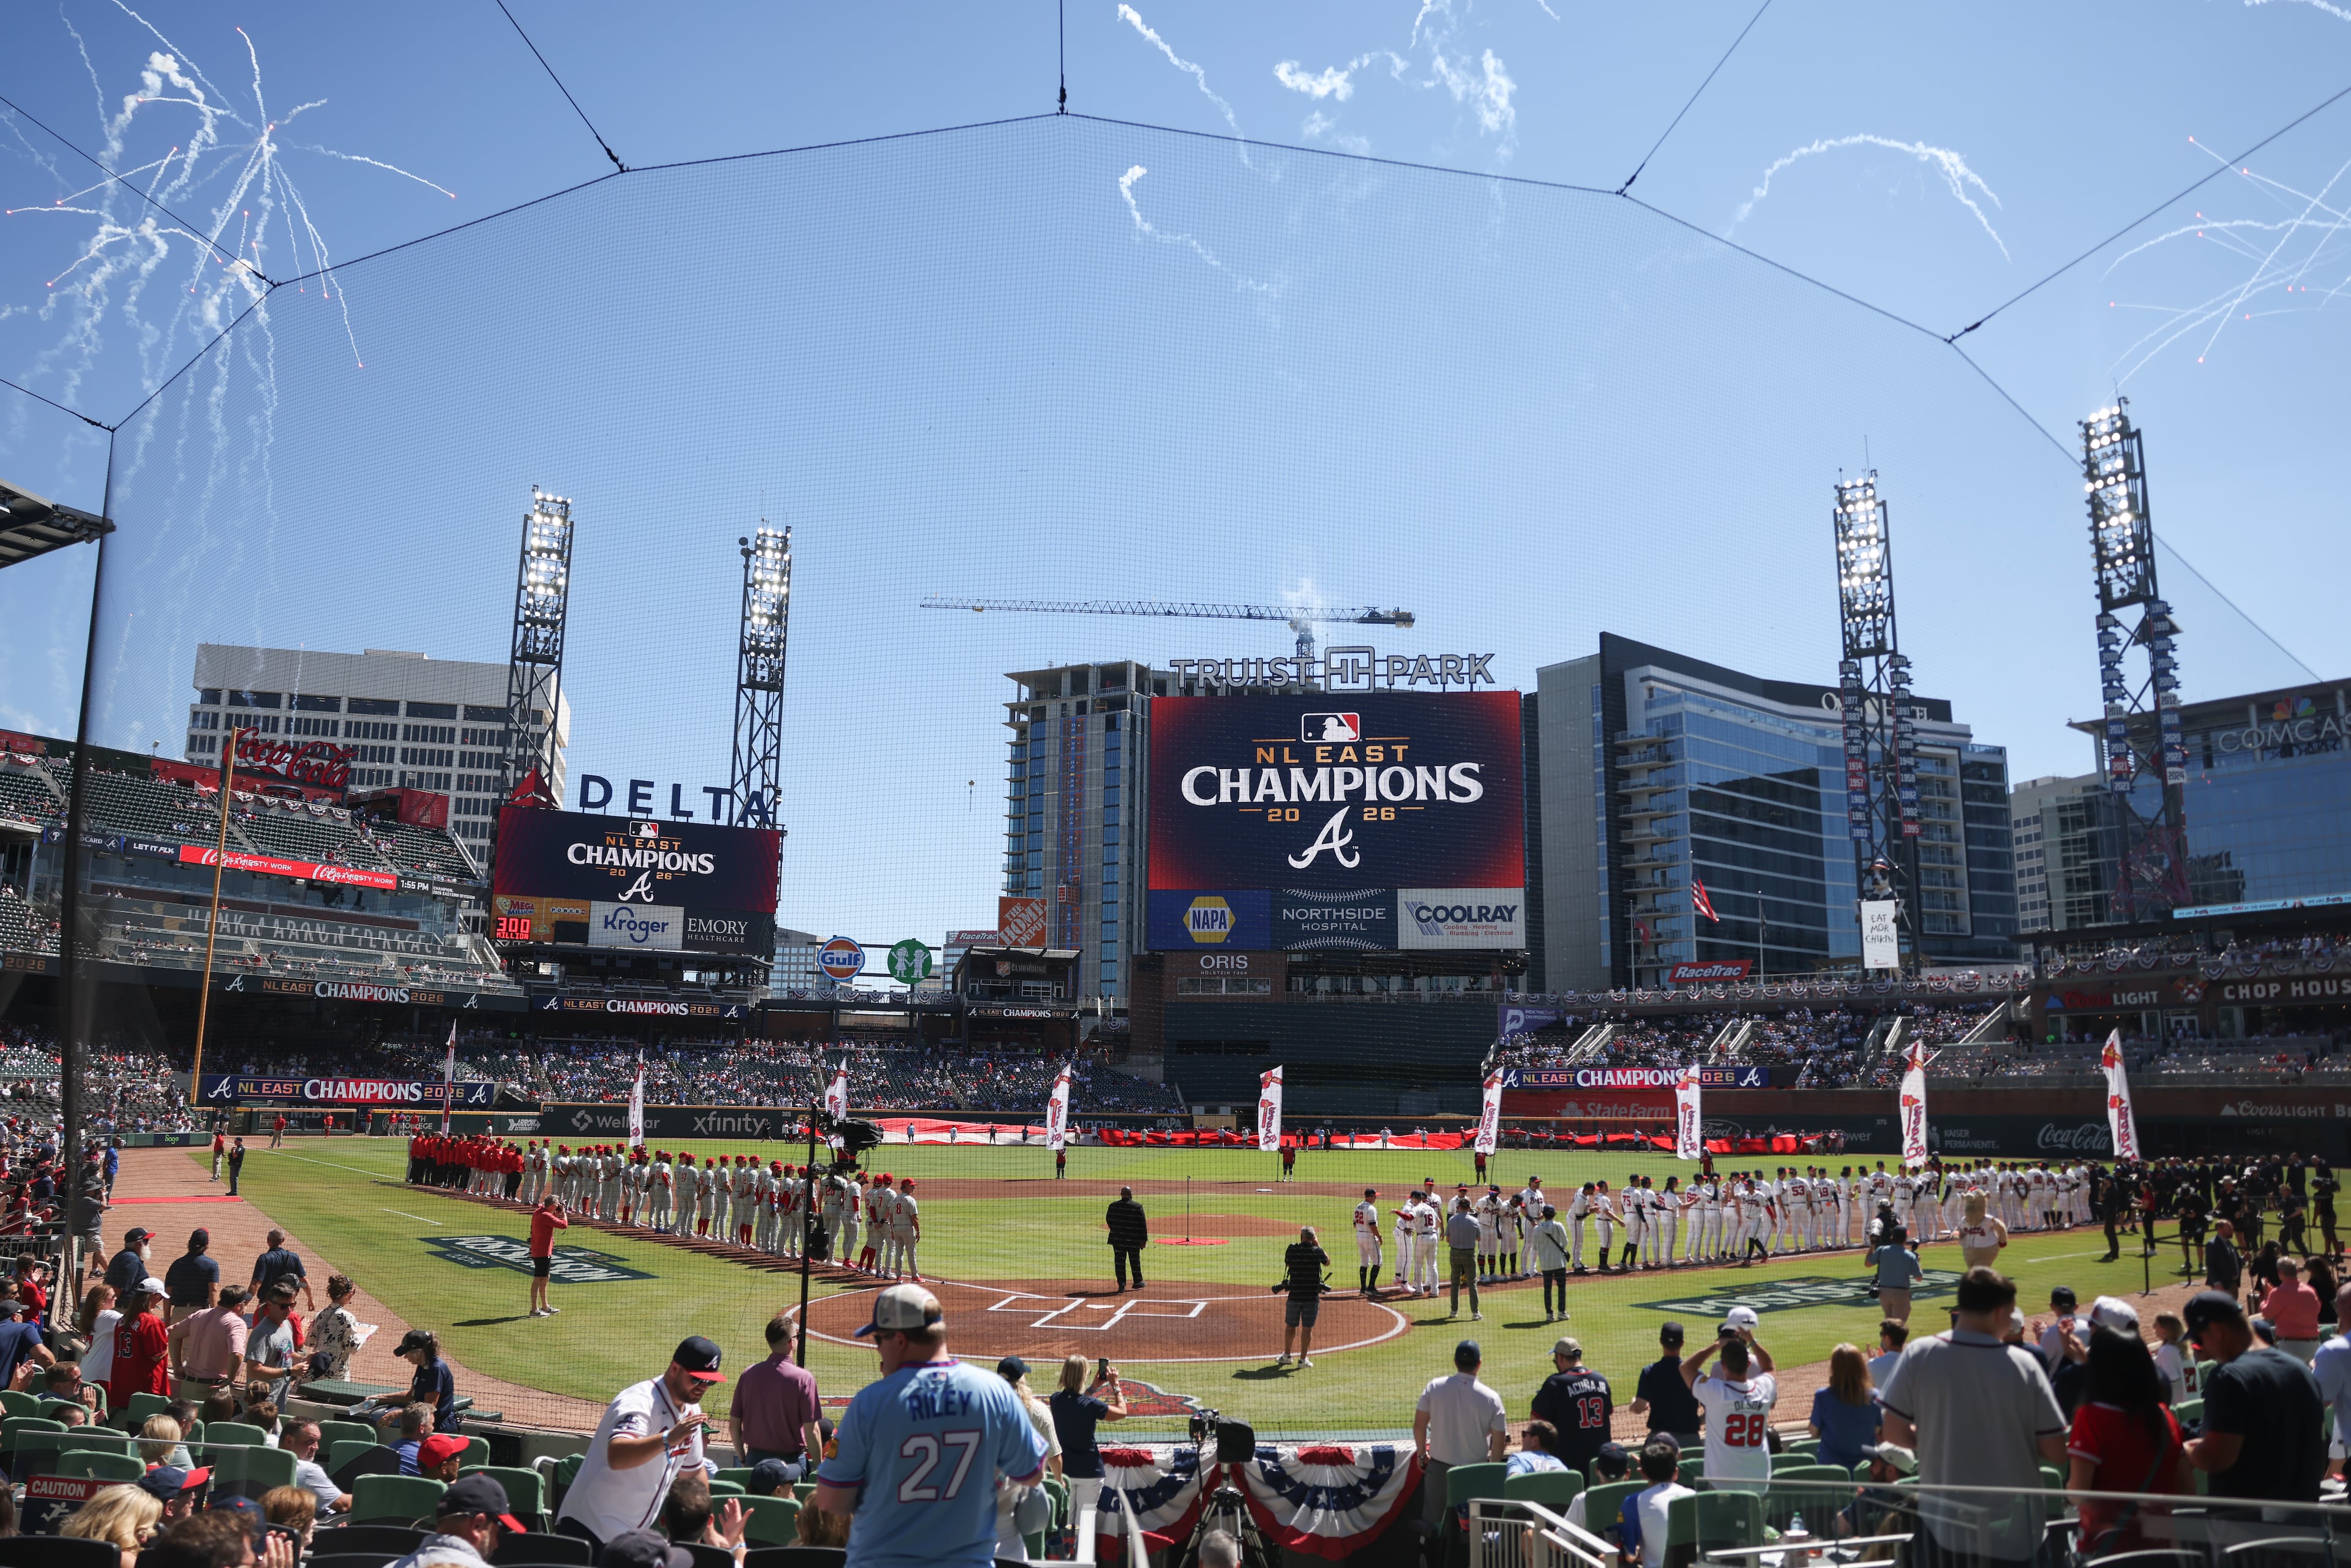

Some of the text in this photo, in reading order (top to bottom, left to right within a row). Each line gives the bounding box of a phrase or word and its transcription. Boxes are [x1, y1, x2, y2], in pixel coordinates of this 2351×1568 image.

[2151, 603, 2167, 612] 1997
[2153, 622, 2169, 631] 1999
[2155, 640, 2171, 649] 2001
[1892, 656, 1907, 665] 1873
[2158, 659, 2173, 667] 2003
[1170, 653, 1496, 689] TRUIST PARK
[1894, 673, 1908, 682] 1875
[2163, 715, 2178, 723] 2018
[1897, 723, 1912, 732] 1893
[2110, 725, 2124, 733] 2013
[2165, 733, 2180, 742] 2020
[1256, 745, 1409, 763] NL EAST
[2112, 743, 2126, 752] 2019
[222, 727, 361, 787] Coca-Cola
[1899, 757, 1914, 765] 1948
[2167, 752, 2182, 761] 2022
[1849, 762, 1862, 770] 1914
[2113, 762, 2128, 770] 2021
[1900, 773, 1915, 782] 1958
[2168, 771, 2184, 780] 2024
[1181, 763, 1484, 806] CHAMPIONS
[1850, 779, 1864, 787] 1957
[2115, 782, 2129, 790] 2023
[579, 774, 772, 825] DELTA
[1902, 790, 1917, 799] 1982
[1267, 807, 1395, 822] 20 26
[1852, 812, 1865, 820] 1991
[606, 836, 681, 851] NL EAST
[567, 843, 714, 874] CHAMPIONS
[400, 880, 429, 891] 1:55 PM
[509, 900, 534, 910] MEGA
[1003, 902, 1024, 921] THE
[1191, 909, 1227, 931] NAPA
[1283, 907, 1386, 921] NORTHSIDE
[1415, 904, 1518, 923] COOLRAY
[1871, 914, 1887, 923] EAT
[497, 917, 531, 934] 300
[604, 906, 669, 943] Kroger
[687, 918, 748, 936] EMORY
[999, 899, 1047, 946] HOME
[1870, 923, 1889, 933] MOR
[688, 934, 745, 943] HEALTHCARE
[1018, 917, 1047, 947] DEPOT
[4, 957, 46, 970] 2026
[821, 952, 860, 966] Gulf
[1200, 955, 1248, 969] ORIS
[1011, 964, 1046, 973] CLUBHOUSE
[1675, 964, 1742, 978] RaceTrac
[263, 981, 443, 1003] NL EAST CHAMPIONS 2026
[2224, 983, 2281, 1000] CHOP
[2064, 989, 2159, 1008] Coors LIGHT
[606, 1000, 689, 1016] CHAMPIONS
[690, 1006, 719, 1015] 2026
[1003, 1008, 1051, 1018] CHAMPIONS
[1523, 1071, 1539, 1083] NL
[1542, 1073, 1575, 1083] EAST
[239, 1079, 422, 1101] NL EAST CHAMPIONS
[291, 1105, 321, 1119] MLB
[2238, 1100, 2282, 1116] Coors
[2285, 1106, 2326, 1117] LIGHT
[692, 1111, 767, 1136] xfinity
[1157, 1116, 1182, 1128] PAPA
[1702, 1123, 1733, 1138] Ford
[1944, 1130, 1970, 1138] KAISER
[2038, 1123, 2111, 1150] Coca-Cola
[165, 1134, 179, 1145] Sage
[1945, 1139, 1997, 1149] PERMANENTE
[1791, 1185, 1805, 1196] 53
[878, 1196, 883, 1207] 7
[1622, 1195, 1631, 1207] 75
[896, 1202, 901, 1214] 8
[1354, 1210, 1364, 1225] 22
[117, 1331, 133, 1359] 13
[1567, 1379, 1596, 1397] ACUÑA
[907, 1389, 972, 1422] RILEY
[1577, 1397, 1603, 1428] 13
[1725, 1414, 1764, 1447] 28
[898, 1429, 982, 1503] 27
[31, 1480, 86, 1498] CAUTION
